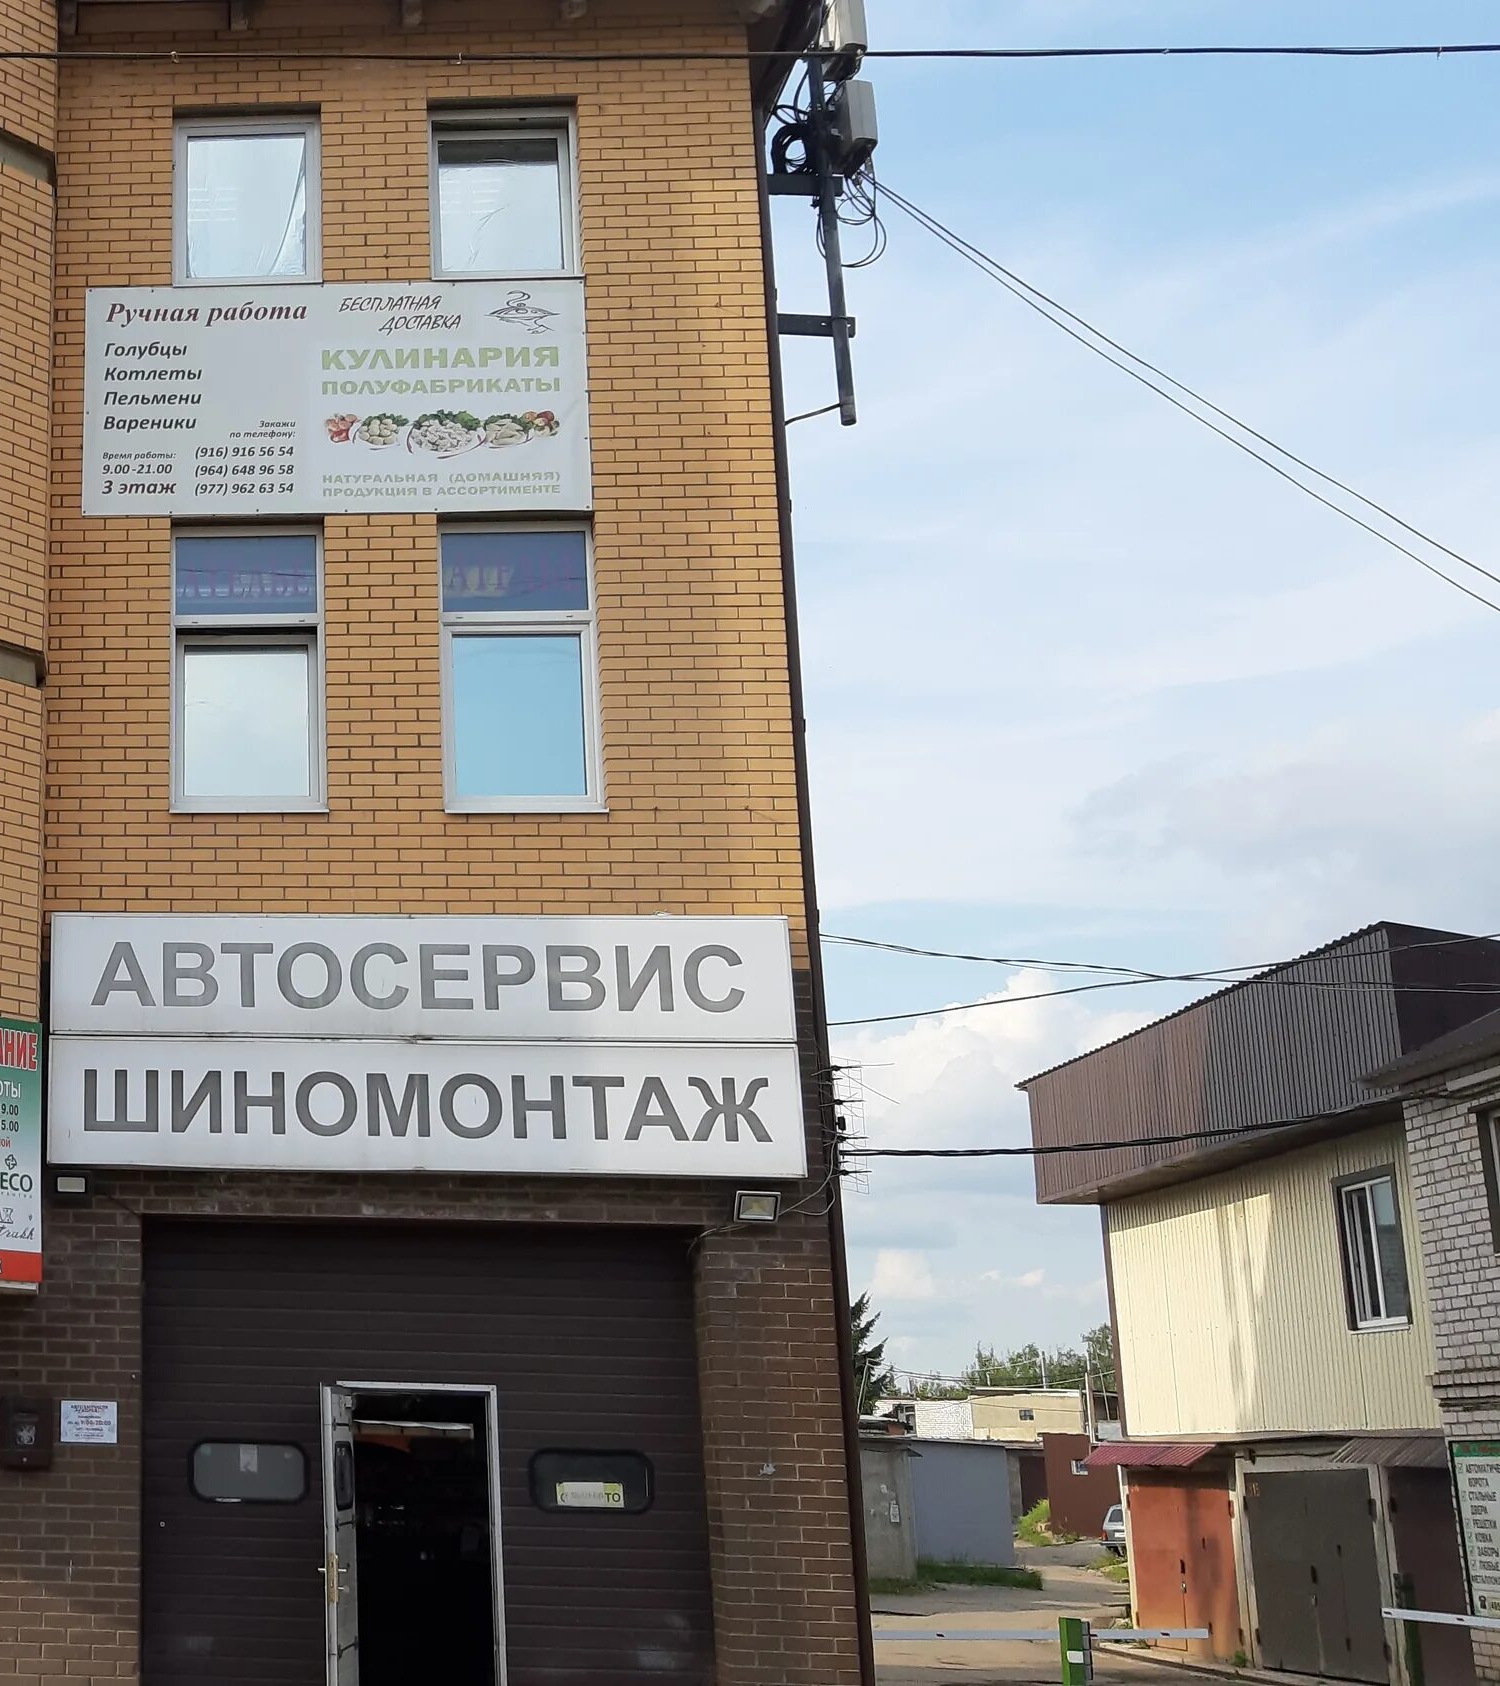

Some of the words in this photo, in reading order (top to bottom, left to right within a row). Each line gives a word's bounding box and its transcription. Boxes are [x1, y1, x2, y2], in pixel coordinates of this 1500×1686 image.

[338, 294, 443, 313] БЕСПЛАТНАЯ
[105, 302, 200, 328] Ручная
[203, 300, 308, 327] работа
[378, 313, 462, 336] ДОСТАВКА
[104, 341, 188, 360] Голубцы
[321, 346, 560, 371] КУЛИНАРИЯ
[104, 367, 203, 381] Котлеты
[321, 377, 561, 396] ПОЛУФАБРИКАТЫ
[103, 391, 202, 406] Пельмени
[103, 415, 197, 433] Вареники
[259, 420, 296, 429] Закажи
[229, 431, 241, 439] по
[243, 430, 296, 440] телефону:
[102, 452, 132, 461] Время
[134, 451, 176, 461] работы:
[195, 446, 228, 460] (916)
[231, 446, 255, 457] 916
[258, 446, 274, 457] 56
[278, 446, 294, 457] 54
[195, 464, 228, 478] (964)
[231, 464, 255, 475] 648
[259, 464, 275, 475] 96
[278, 464, 294, 475] 58
[322, 473, 439, 484] НАТУРАЛЬНАЯ
[448, 471, 561, 484] (ДОМАШНЯЯ)
[101, 480, 113, 494] 3
[118, 481, 177, 495] этаж
[194, 483, 228, 497] (977)
[231, 483, 255, 494] 962
[259, 483, 274, 493] 63
[278, 483, 294, 493] 54
[322, 487, 418, 498] ПРОДУКЦИЯ
[422, 487, 433, 496] В
[437, 484, 561, 496] АССОРТИМЕНТЕ
[90, 941, 746, 1014] АВТОСЕРВИС
[83, 1068, 774, 1144] ШИНОМОНТАЖ
